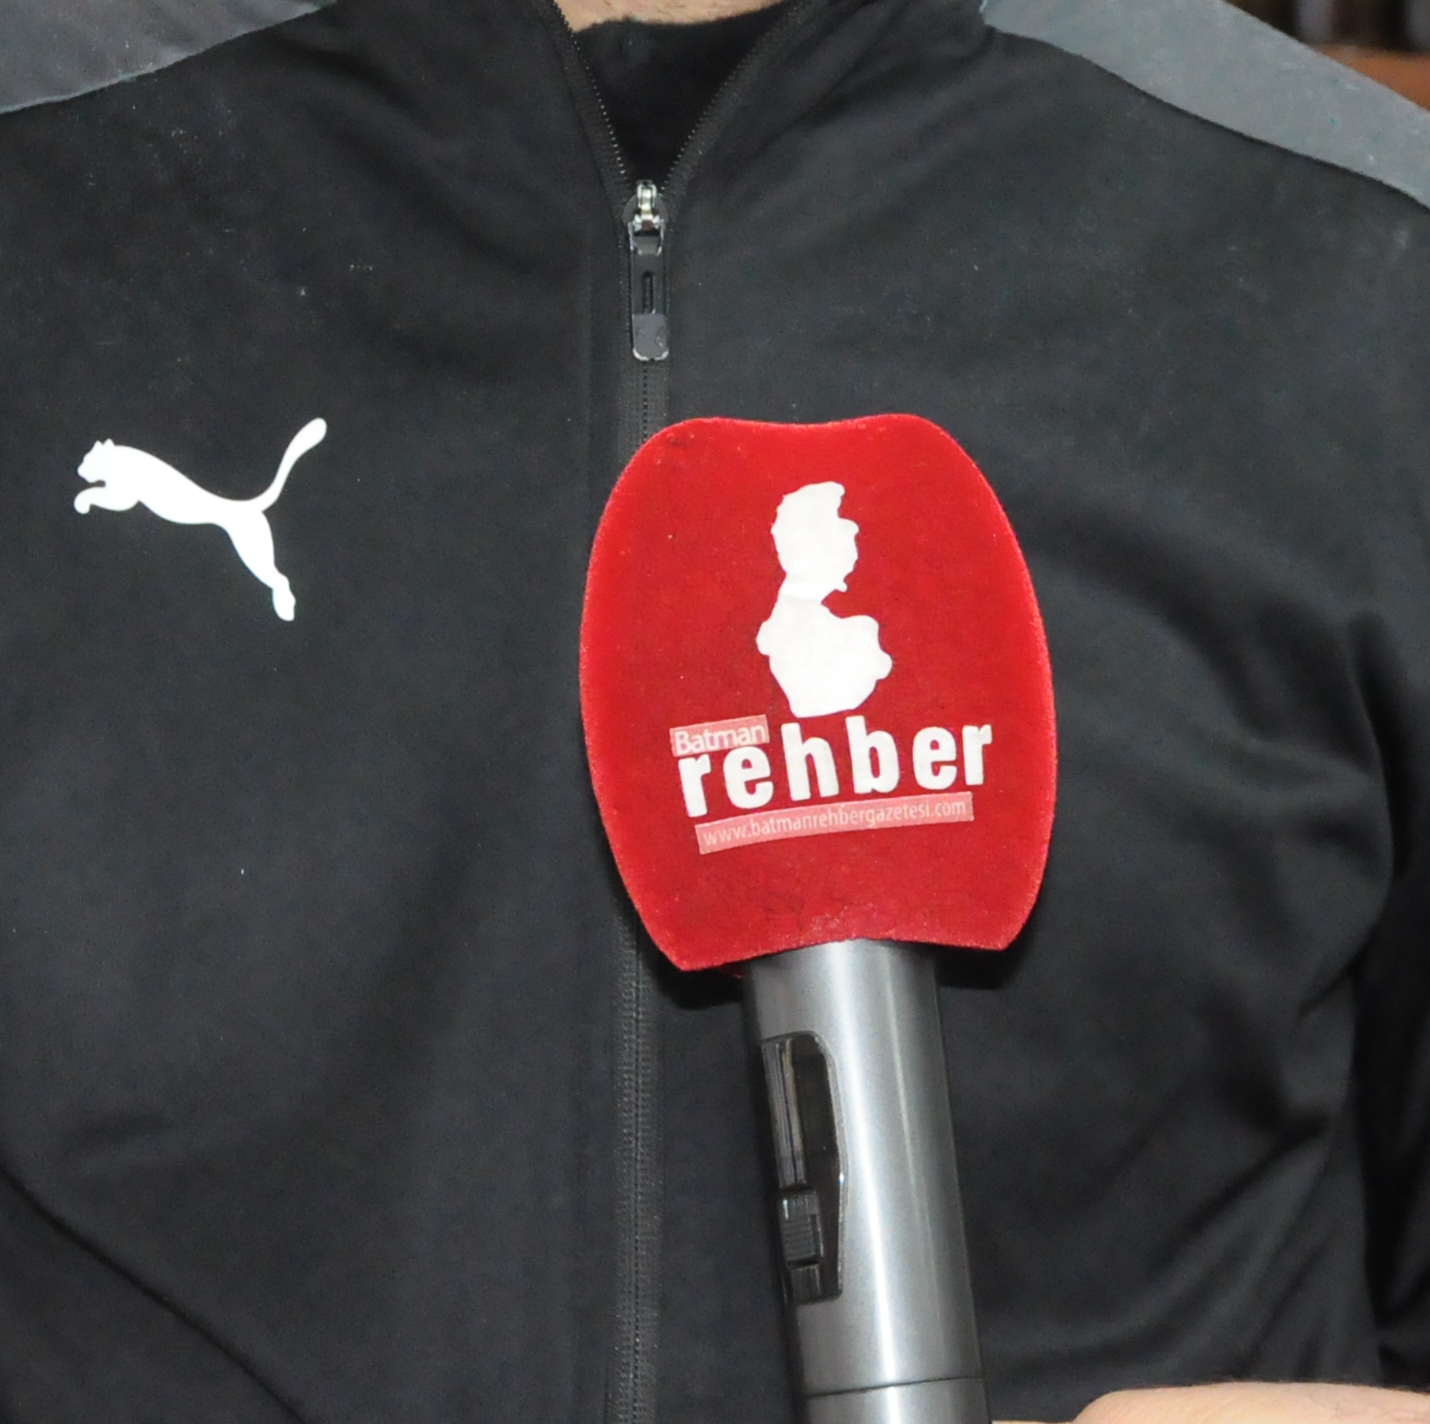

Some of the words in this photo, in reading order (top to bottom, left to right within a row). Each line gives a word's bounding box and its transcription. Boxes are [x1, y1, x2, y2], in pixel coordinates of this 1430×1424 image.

[675, 723, 768, 755] Batman
[678, 714, 993, 818] rehber
[701, 798, 968, 848] www.batmanrehbergazetesi.com
